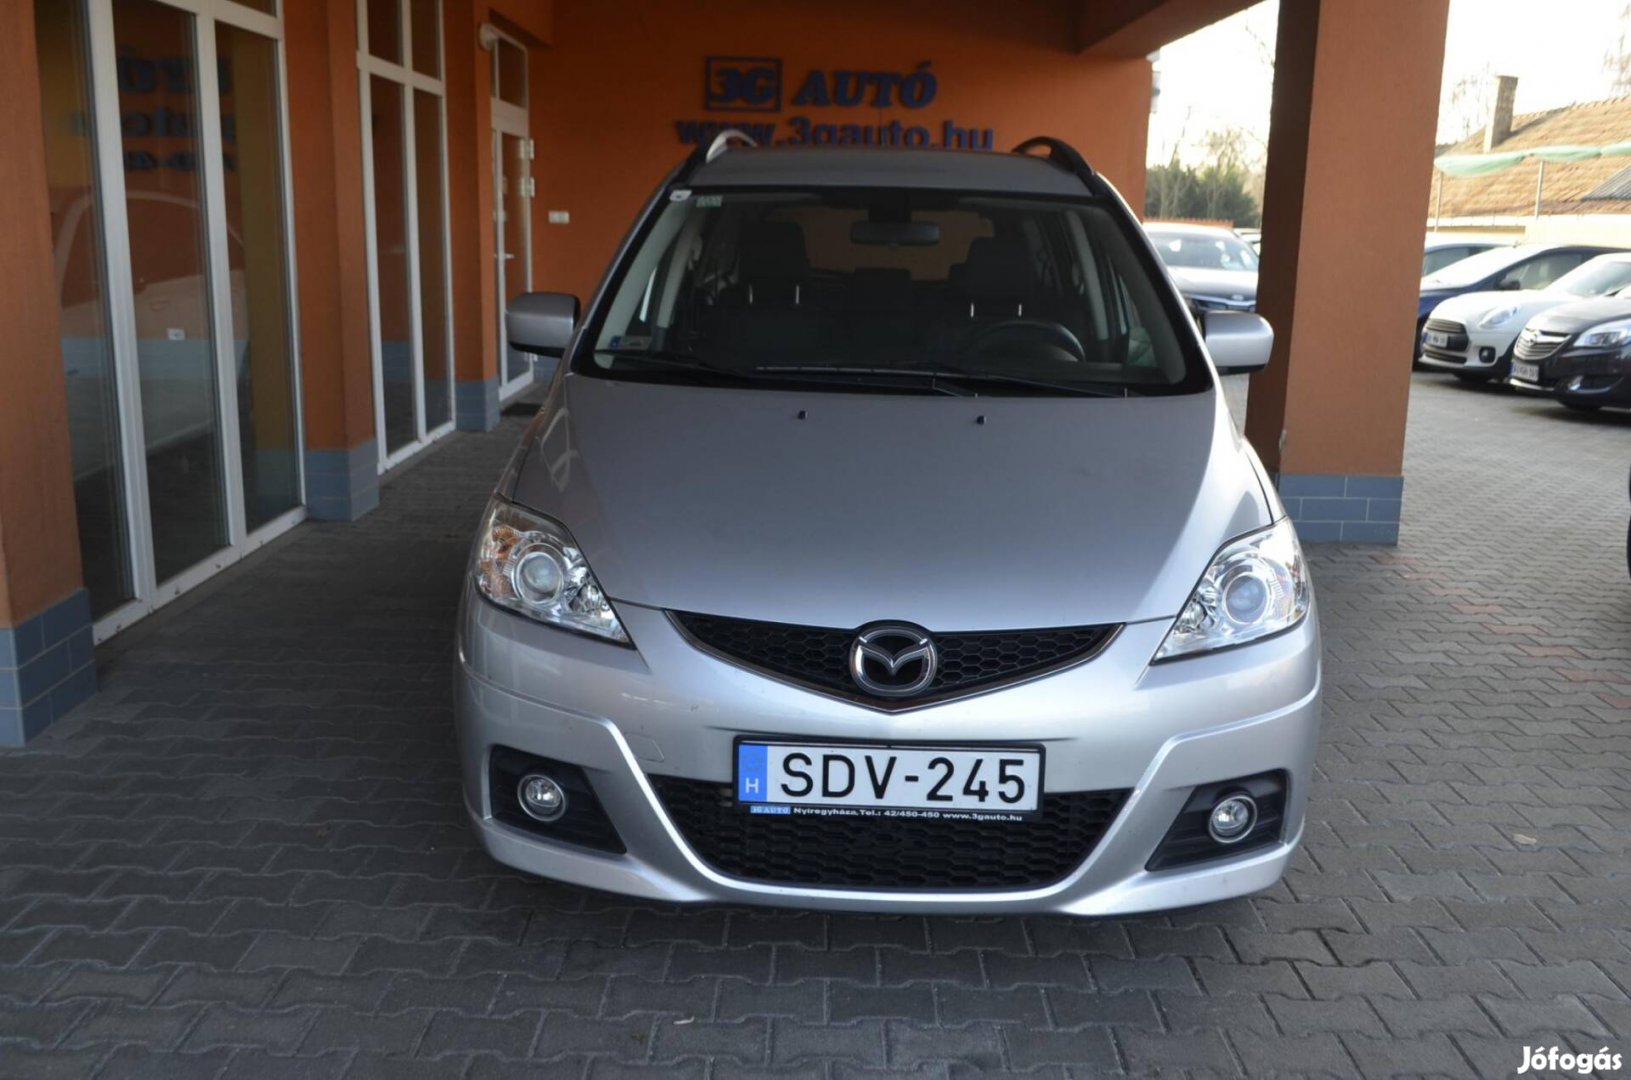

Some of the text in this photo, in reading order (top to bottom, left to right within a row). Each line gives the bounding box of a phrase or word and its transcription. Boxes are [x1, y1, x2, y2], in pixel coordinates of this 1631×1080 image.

[715, 60, 937, 108] 3G AUTÓ
[746, 777, 759, 794] H
[780, 752, 1026, 804] SDV-245
[942, 812, 1023, 821] www.3gauto.hu
